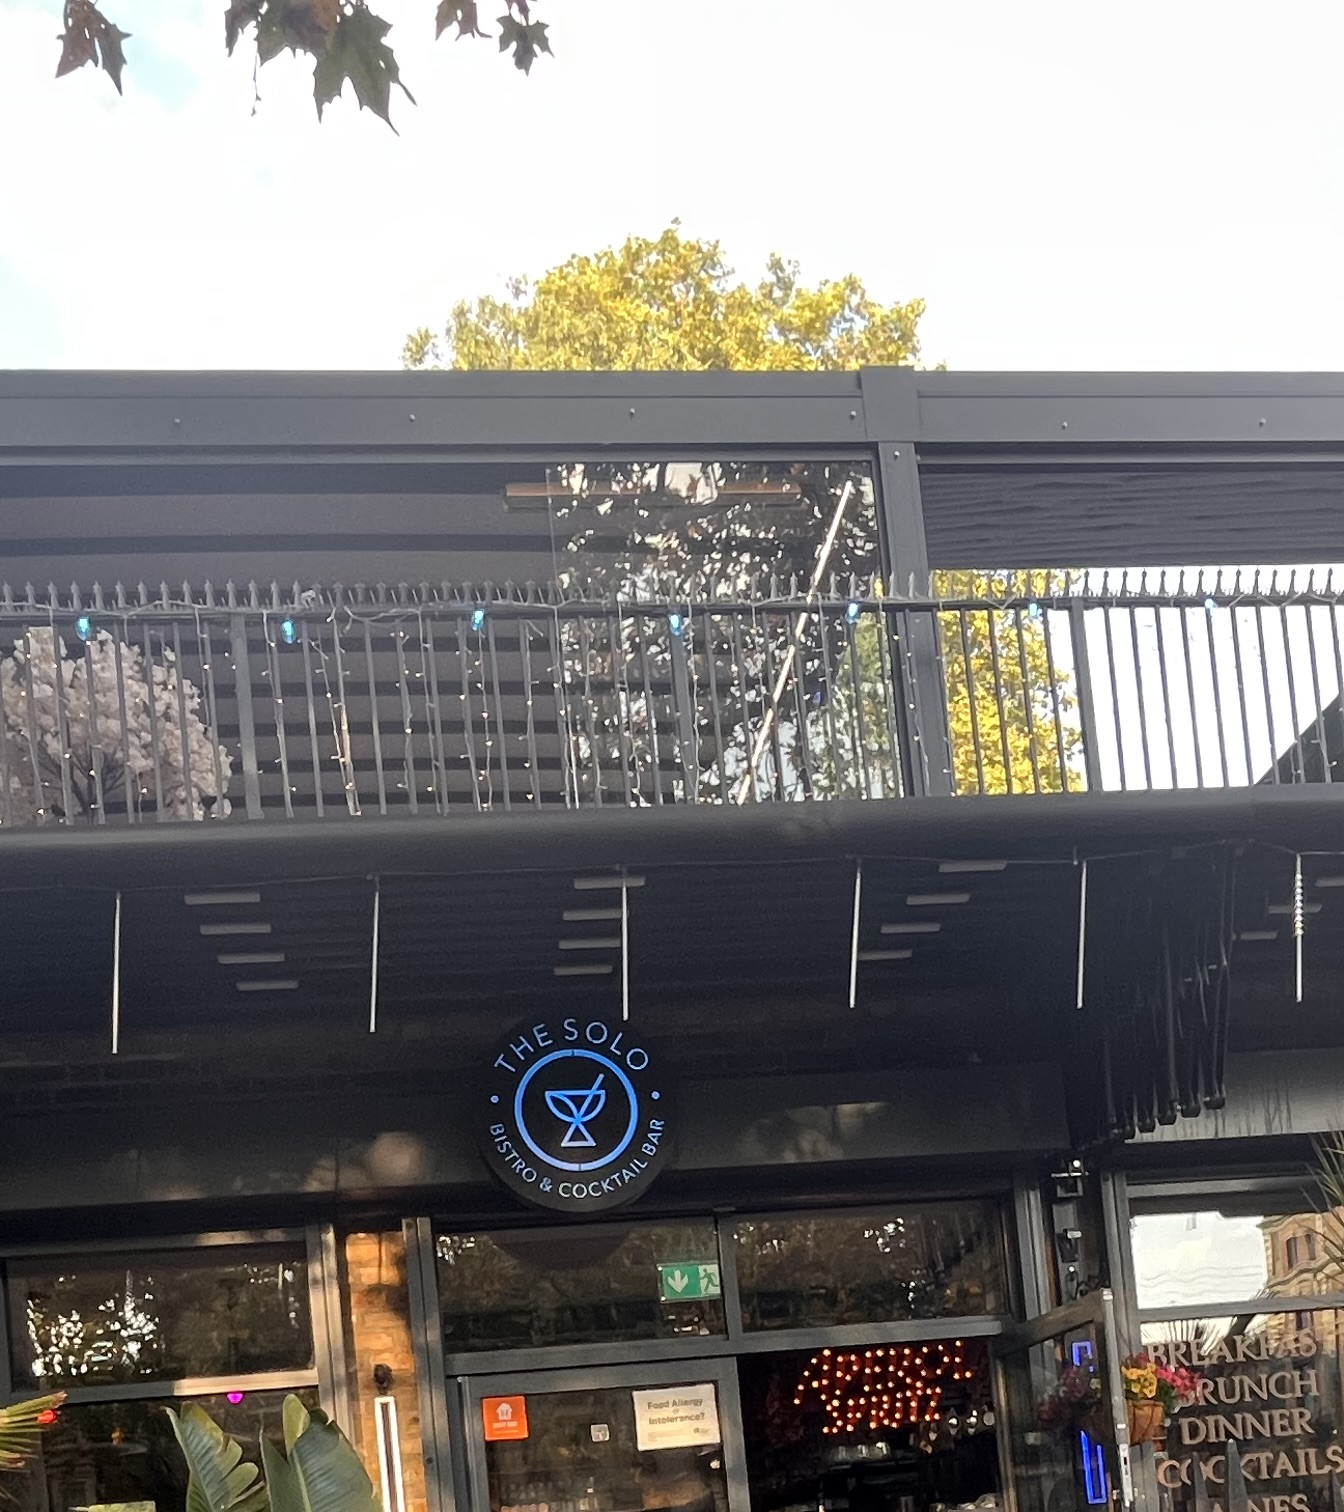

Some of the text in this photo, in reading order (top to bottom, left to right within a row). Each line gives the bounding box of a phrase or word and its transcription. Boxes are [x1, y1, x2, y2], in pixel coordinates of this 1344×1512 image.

[493, 1018, 649, 1073] THE SOLO
[490, 1118, 665, 1199] BISTRO & COCKTAIL BAR
[1179, 1407, 1315, 1445] DINNER
